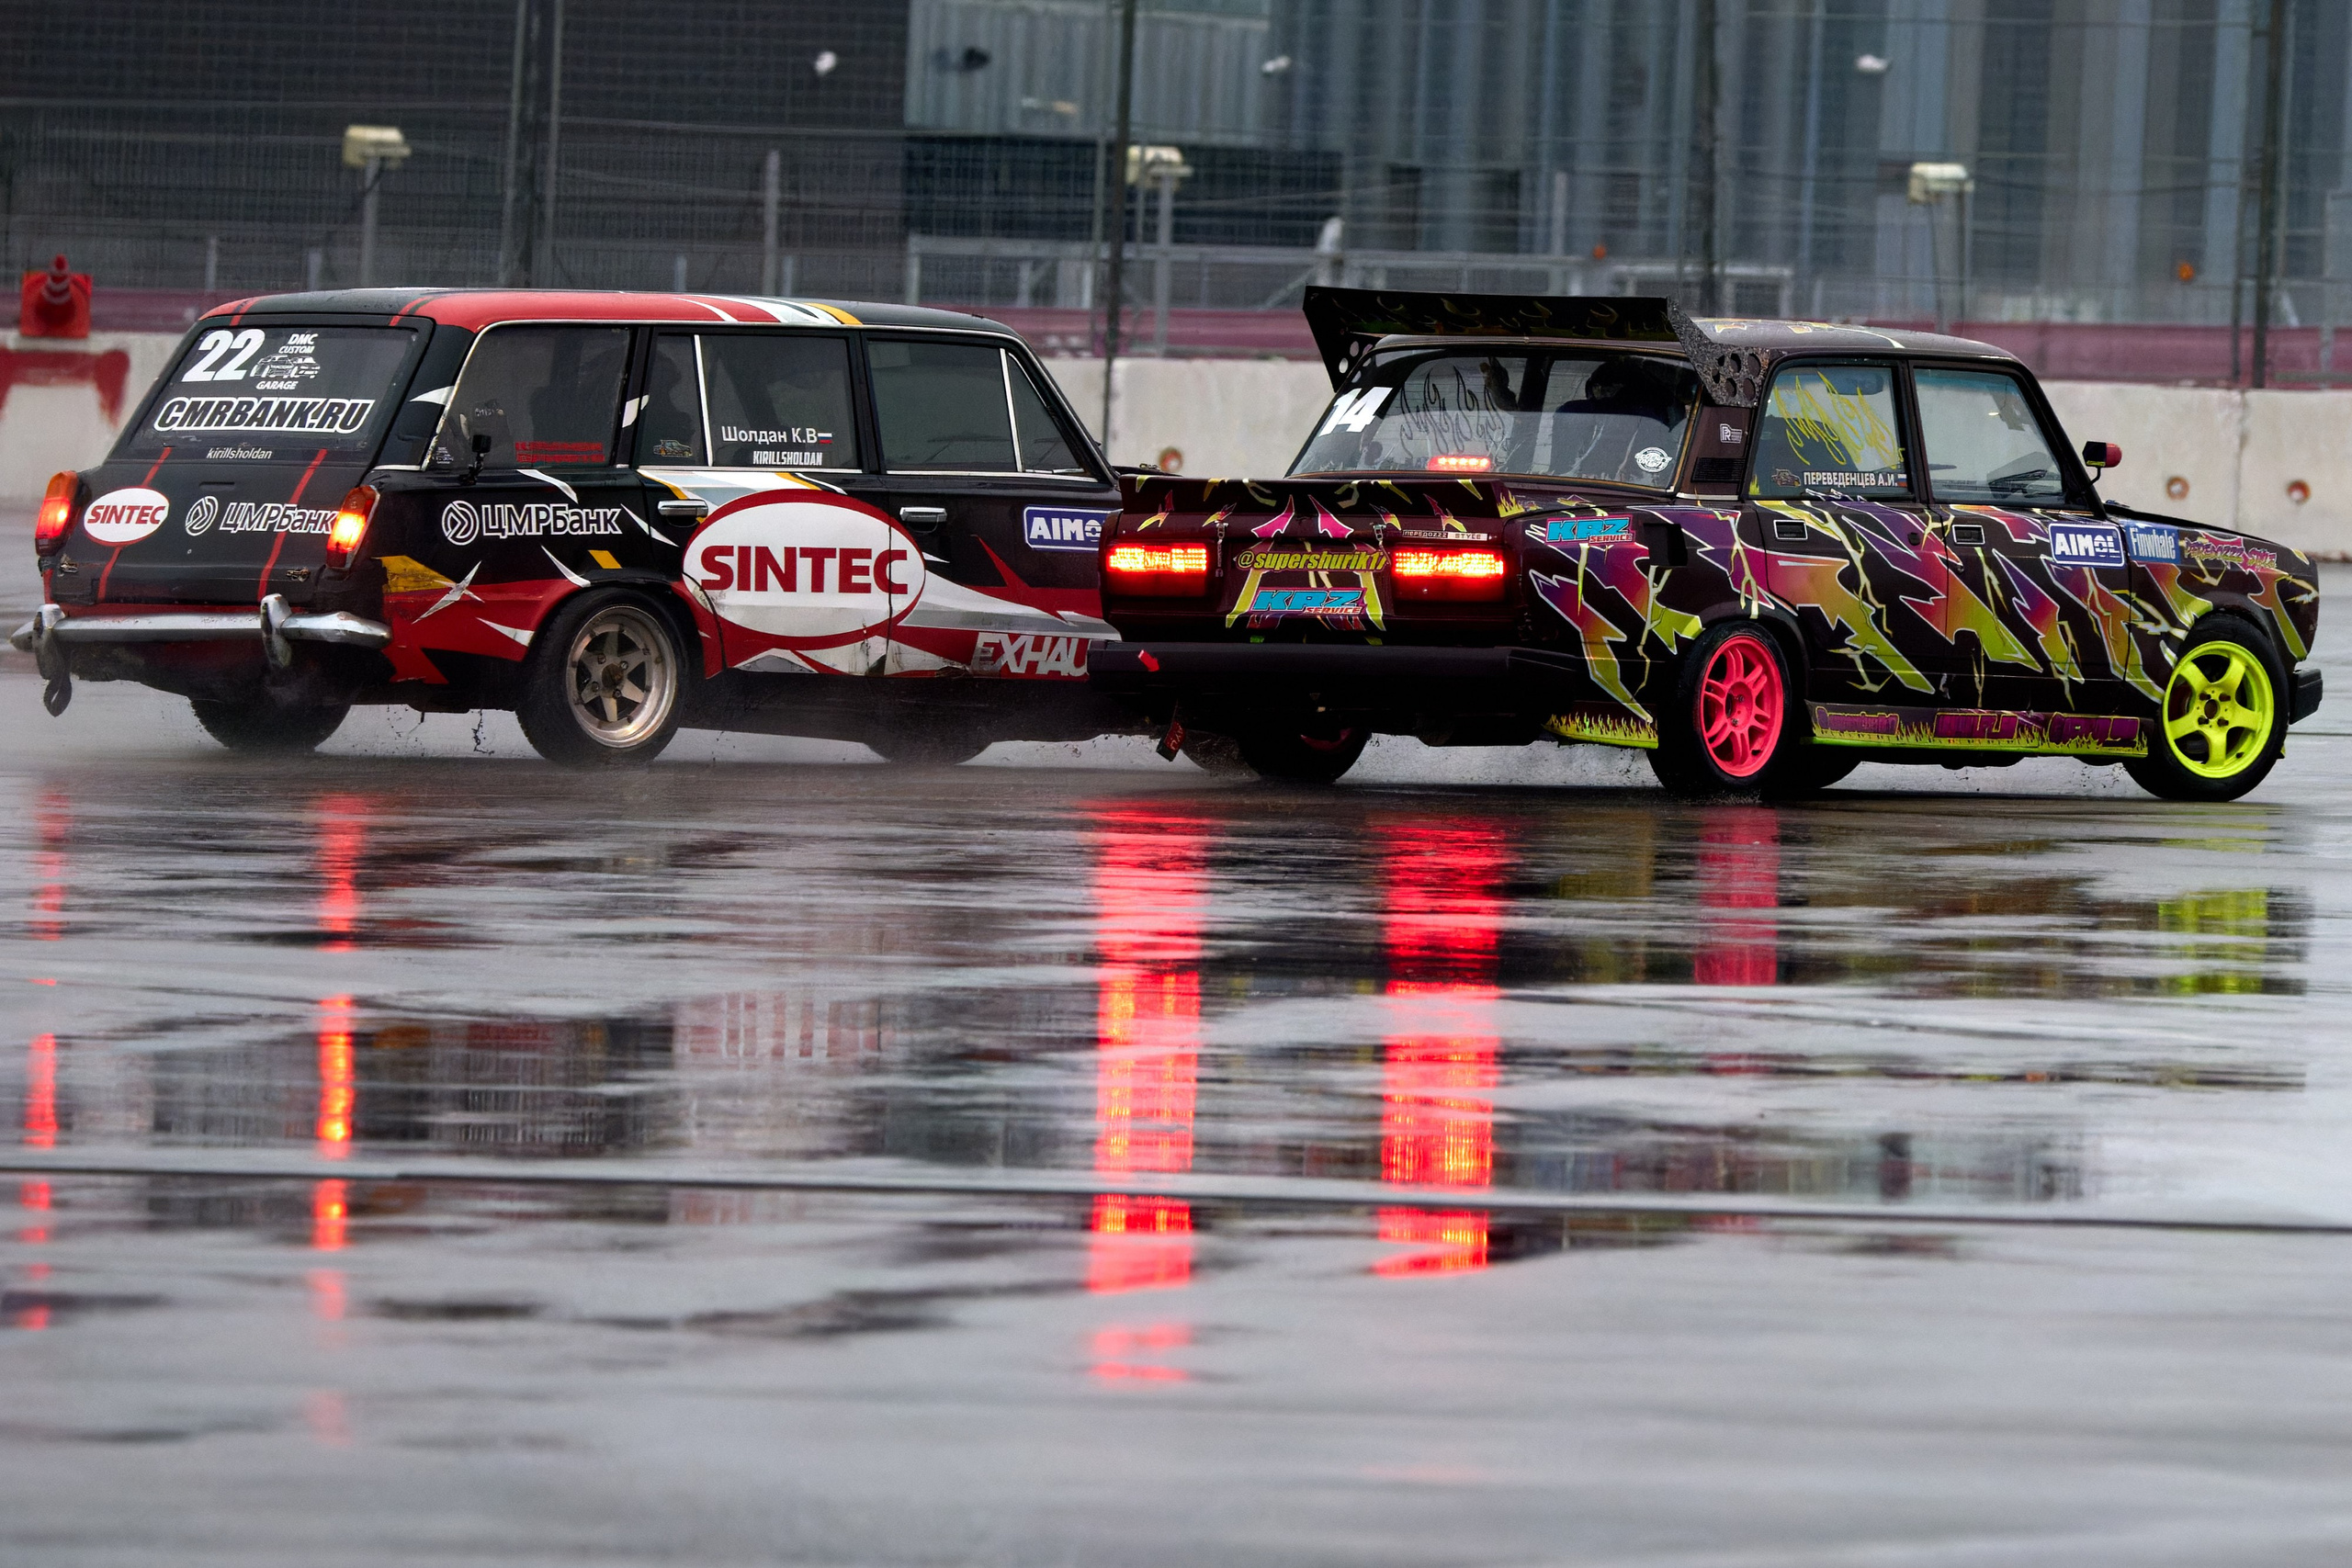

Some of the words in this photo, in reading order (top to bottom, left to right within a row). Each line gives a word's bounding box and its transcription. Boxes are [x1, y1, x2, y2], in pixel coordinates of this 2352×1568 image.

[288, 333, 319, 345] DMC
[182, 329, 266, 382] 22
[278, 346, 315, 355] CUSTOM
[255, 381, 299, 390] GARAGE
[154, 397, 376, 434] CMRBANK.RU
[1319, 386, 1394, 437] 14
[721, 426, 787, 445] Шолдан
[206, 447, 272, 459] kirillsholdan
[752, 451, 823, 466] KIRILLSHOLDAN
[1803, 471, 1876, 488] ПЕРЕВЕДЕНЦЕВ
[87, 505, 166, 525] SINTEC
[220, 502, 341, 534] ЦМРБанк
[481, 503, 623, 539] ЦМРБанк
[1030, 517, 1102, 543] AIMO
[1546, 518, 1630, 543] KRZ
[1589, 533, 1634, 544] SERVICE
[2054, 533, 2121, 558] AIMOL
[2129, 526, 2177, 559] Finwhale
[700, 546, 908, 595] SINTEC
[1250, 590, 1363, 611] KRZ
[1305, 606, 1363, 615] SERVICE
